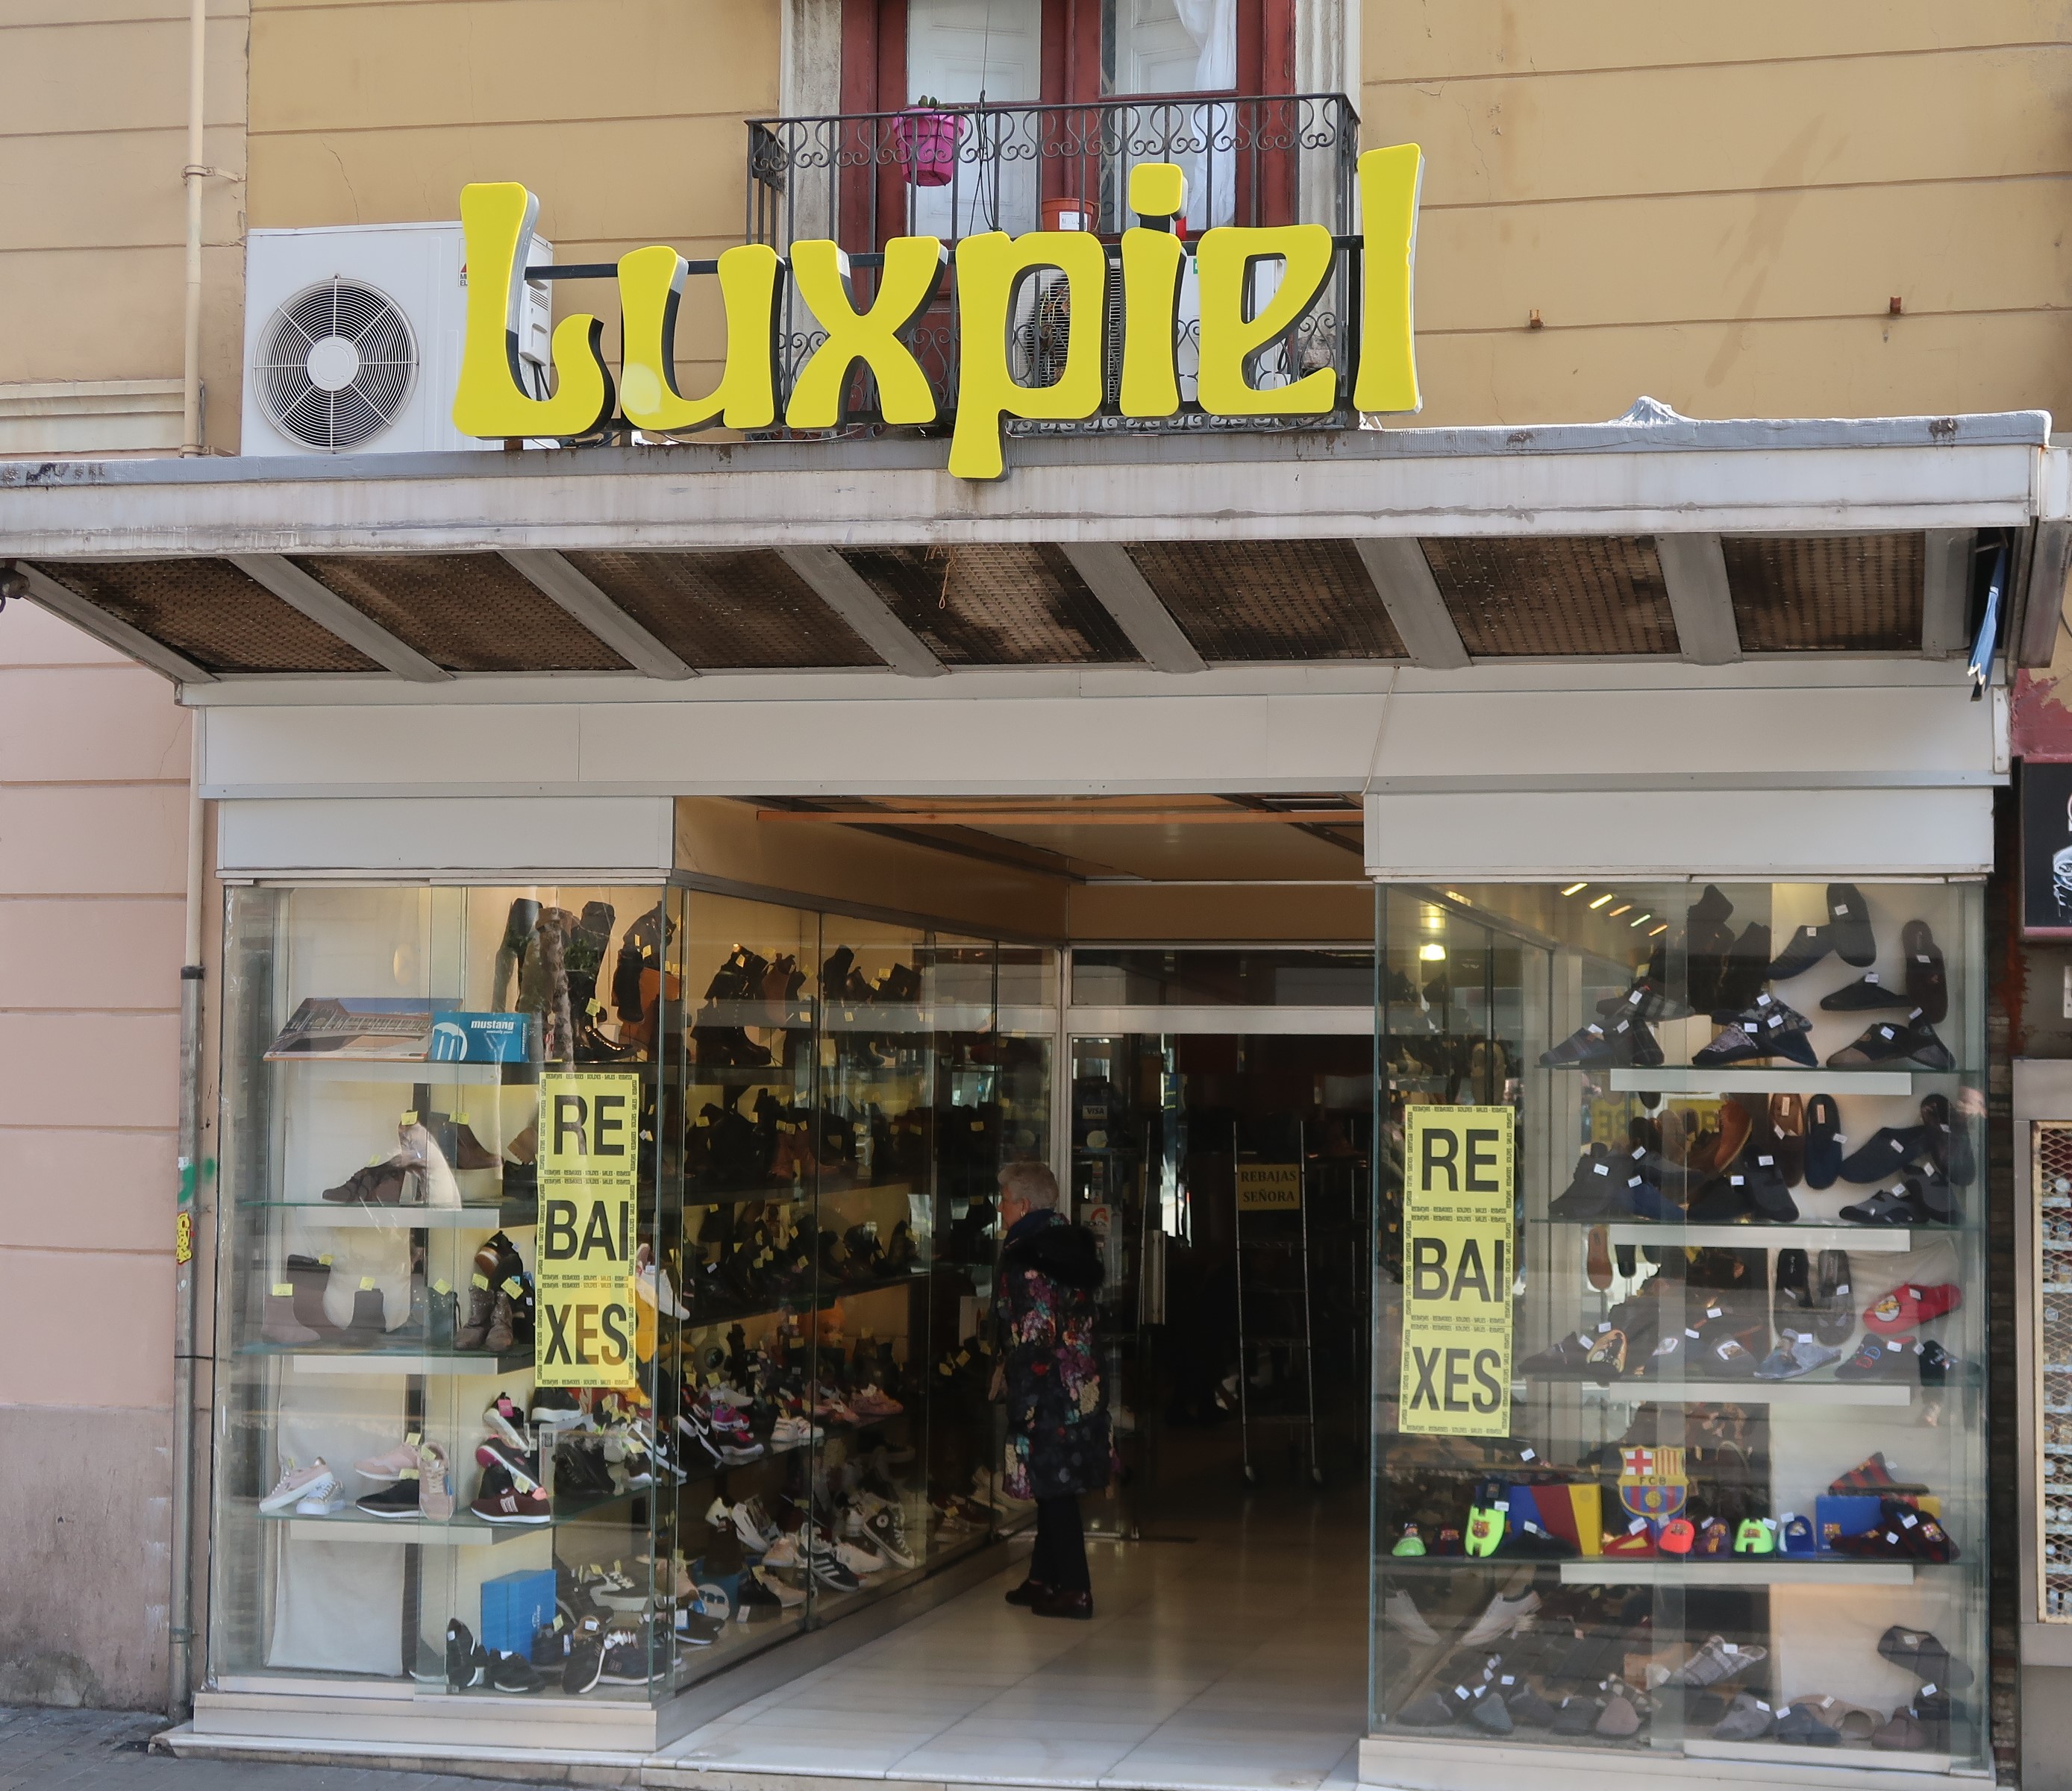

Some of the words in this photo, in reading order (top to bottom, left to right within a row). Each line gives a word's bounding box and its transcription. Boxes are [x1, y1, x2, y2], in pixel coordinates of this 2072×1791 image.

[451, 143, 1423, 480] Luxpiel
[471, 1020, 514, 1029] mustang
[553, 1094, 625, 1155] RE
[1241, 1170, 1296, 1183] REBAJAS
[1421, 1128, 1499, 1192] RE
[1243, 1189, 1295, 1202] SEÑORA
[544, 1199, 629, 1261] BAI
[1412, 1238, 1503, 1302] BAI
[543, 1304, 628, 1366] XES
[1409, 1346, 1501, 1414] XES
[1638, 1476, 1666, 1485] FCB
